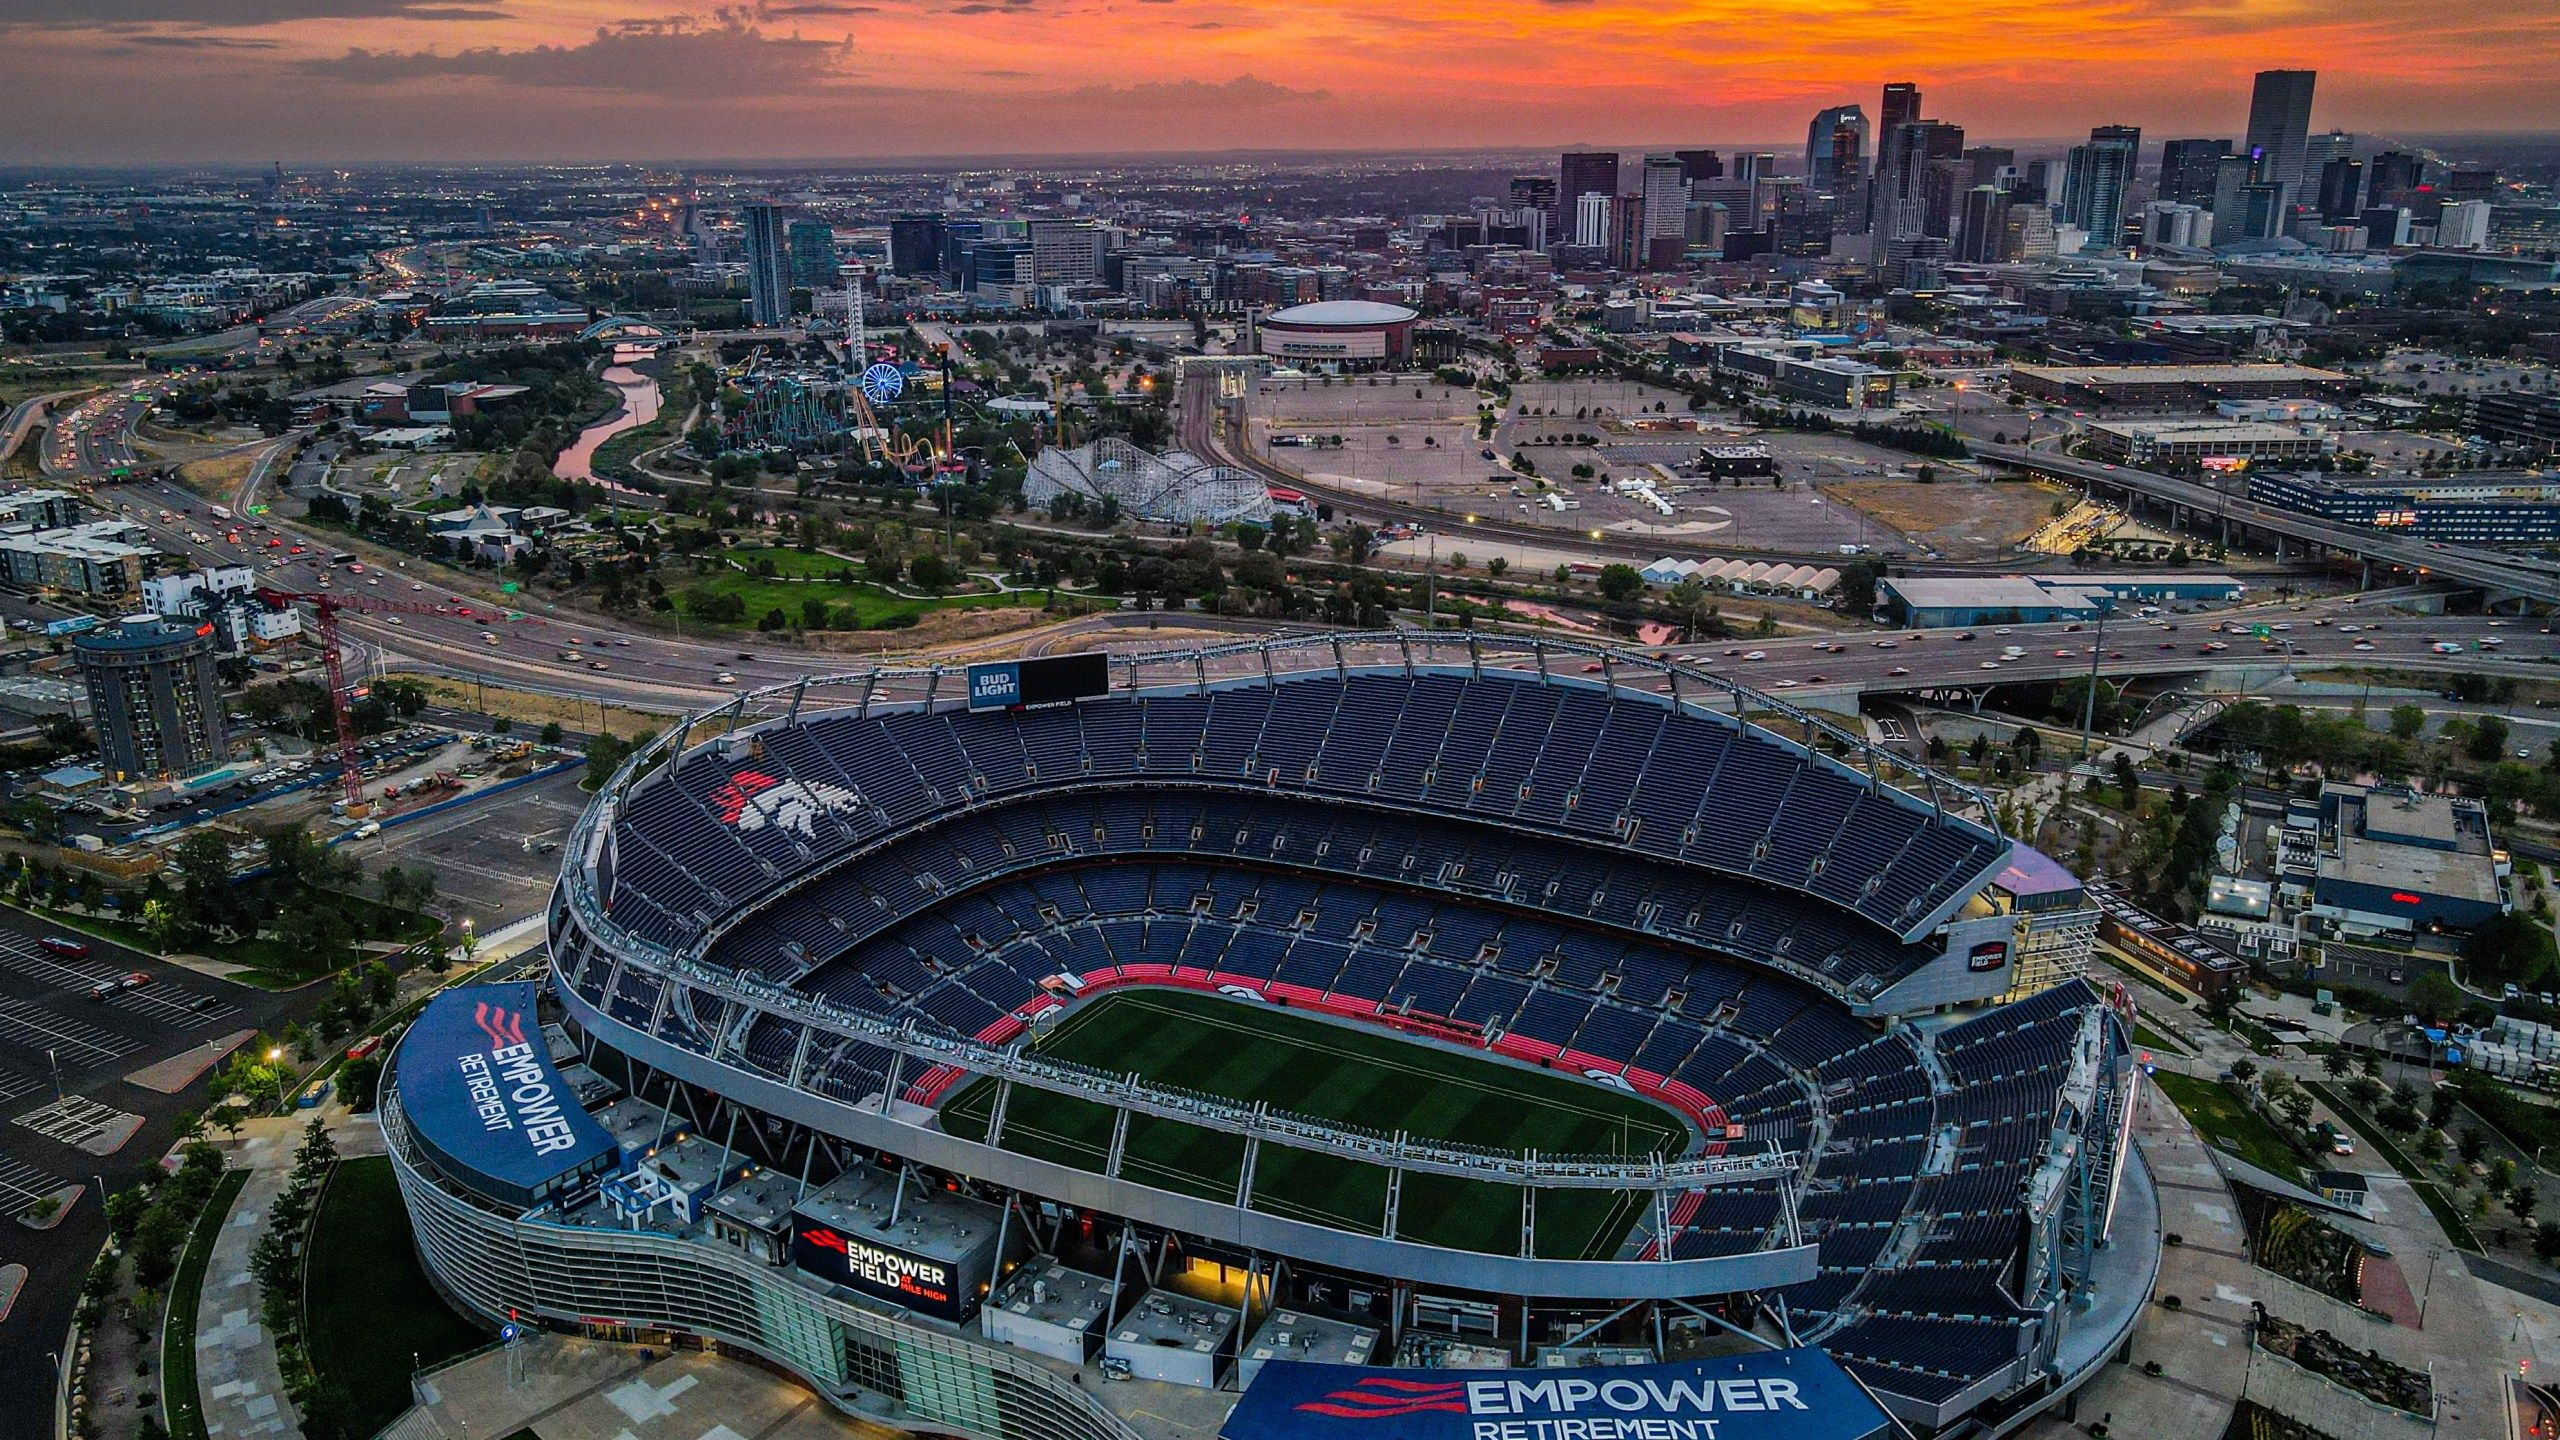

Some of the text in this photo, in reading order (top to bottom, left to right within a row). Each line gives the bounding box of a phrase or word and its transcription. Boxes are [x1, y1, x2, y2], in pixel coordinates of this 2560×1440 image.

[974, 682, 1016, 697] LIGHT
[979, 673, 1010, 686] BUD
[1025, 700, 1072, 711] EMPOWER FIELD
[457, 1052, 514, 1131] RETIREMENT
[492, 1042, 576, 1157] EMPOWER
[847, 1240, 946, 1286] EMPOWER
[849, 1258, 912, 1288] FIELD AT
[900, 1283, 947, 1302] MILE HIGH
[1466, 1378, 1809, 1414] EMPOWER
[1473, 1419, 1720, 1440] RETIREMENT
